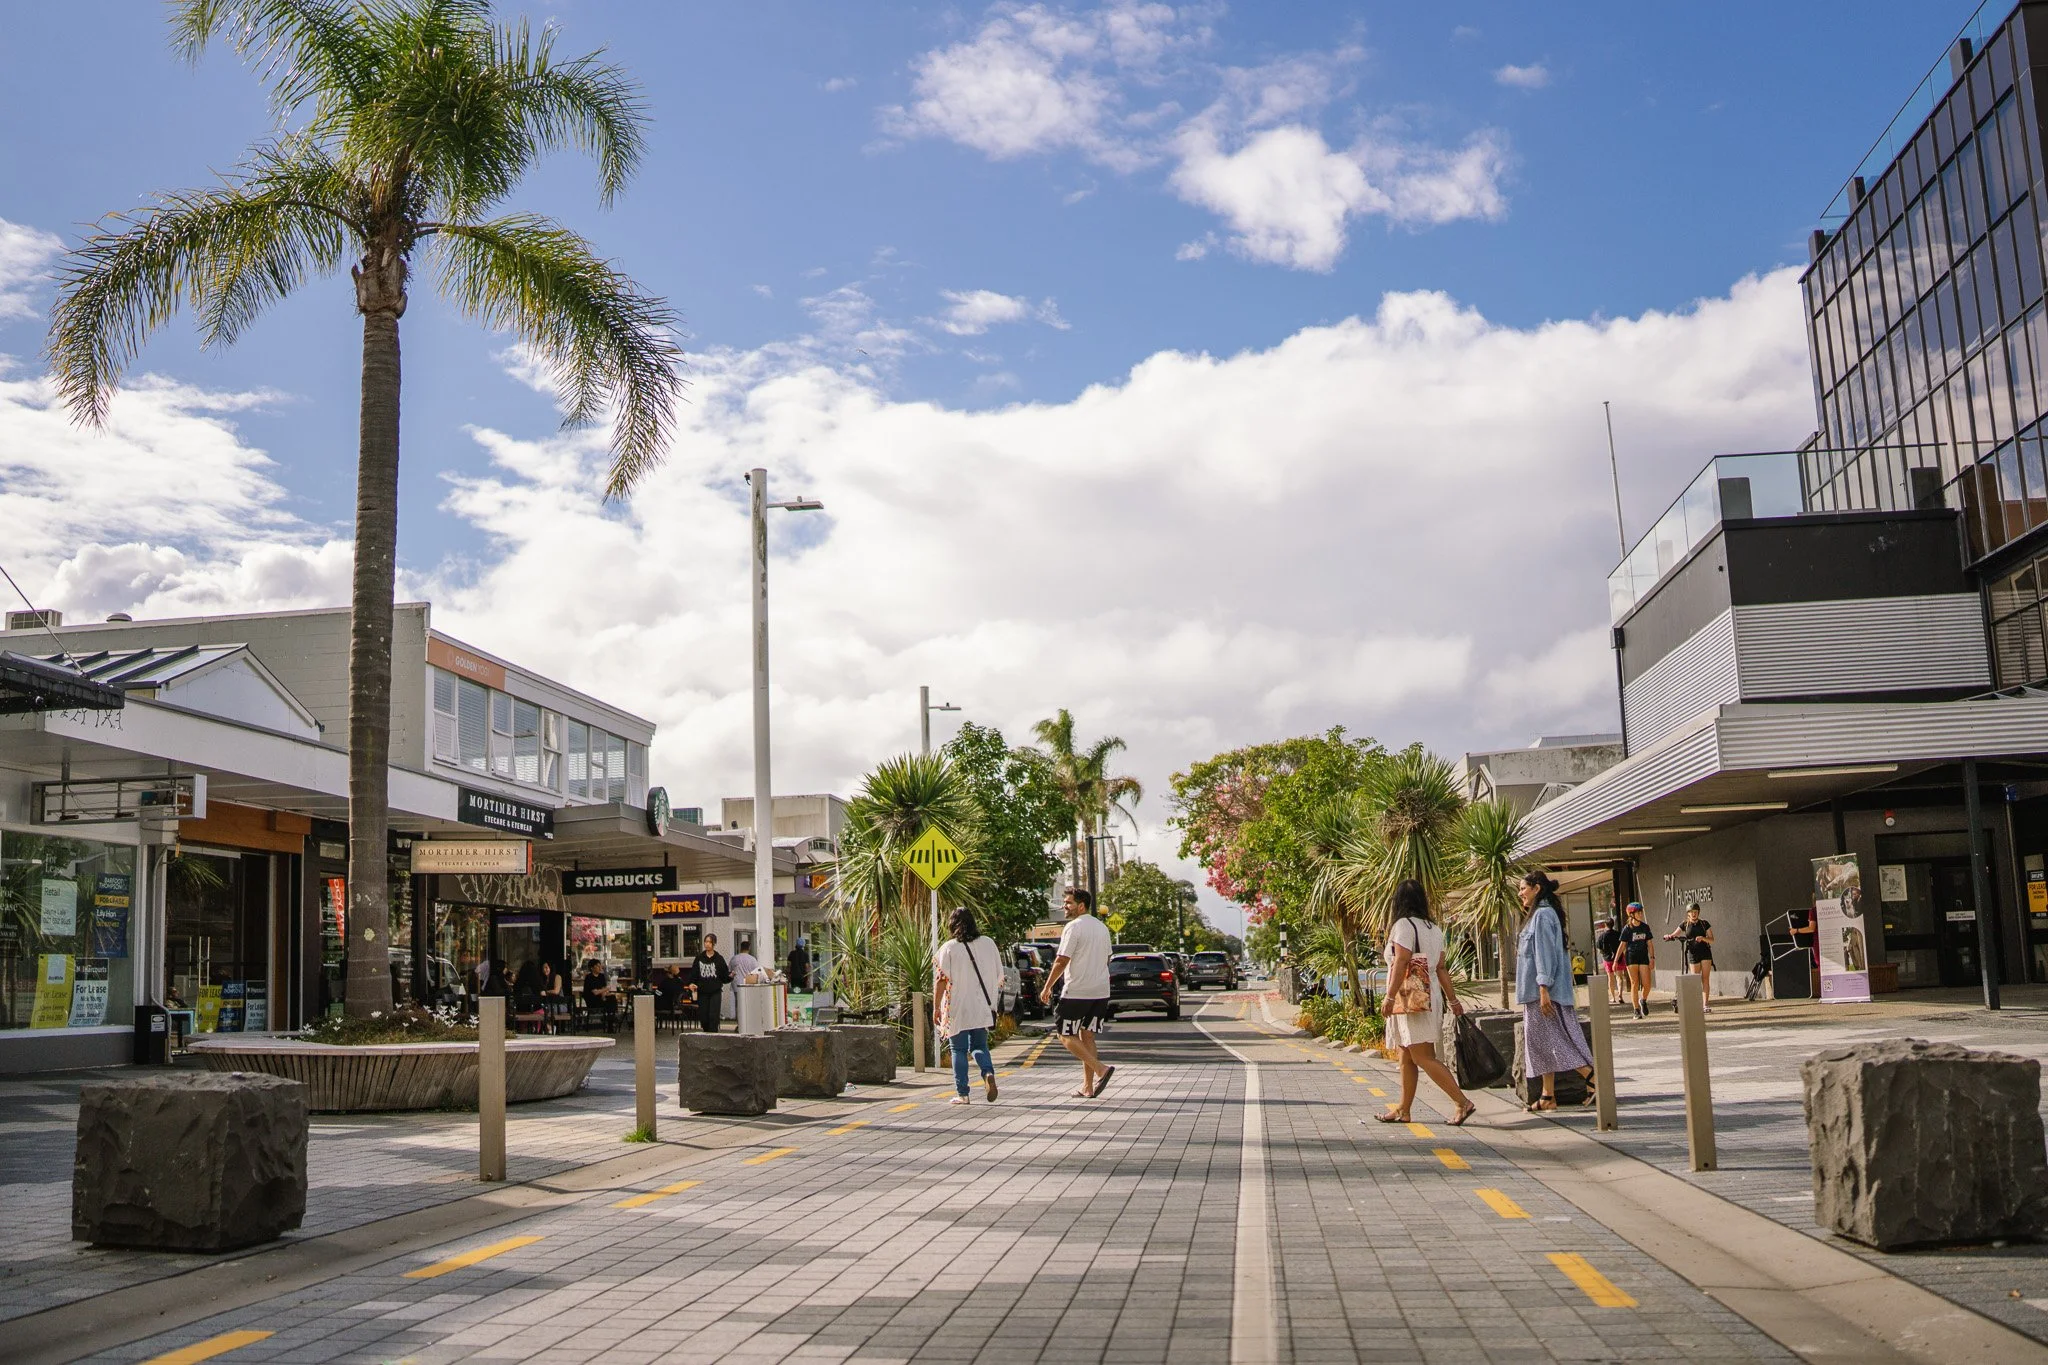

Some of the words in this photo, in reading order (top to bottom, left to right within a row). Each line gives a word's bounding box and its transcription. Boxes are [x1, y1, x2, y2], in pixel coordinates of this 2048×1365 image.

[455, 655, 478, 673] GOLDEN
[469, 794, 518, 818] MORTIMER
[520, 807, 546, 824] HIRST
[484, 815, 506, 827] EYECARE
[511, 821, 533, 833] EYEWEAR
[419, 848, 479, 856] MORTIMER
[484, 848, 519, 856] HIRST
[575, 873, 664, 888] STARBUCKS
[76, 984, 87, 994] For
[89, 984, 107, 994] Lease
